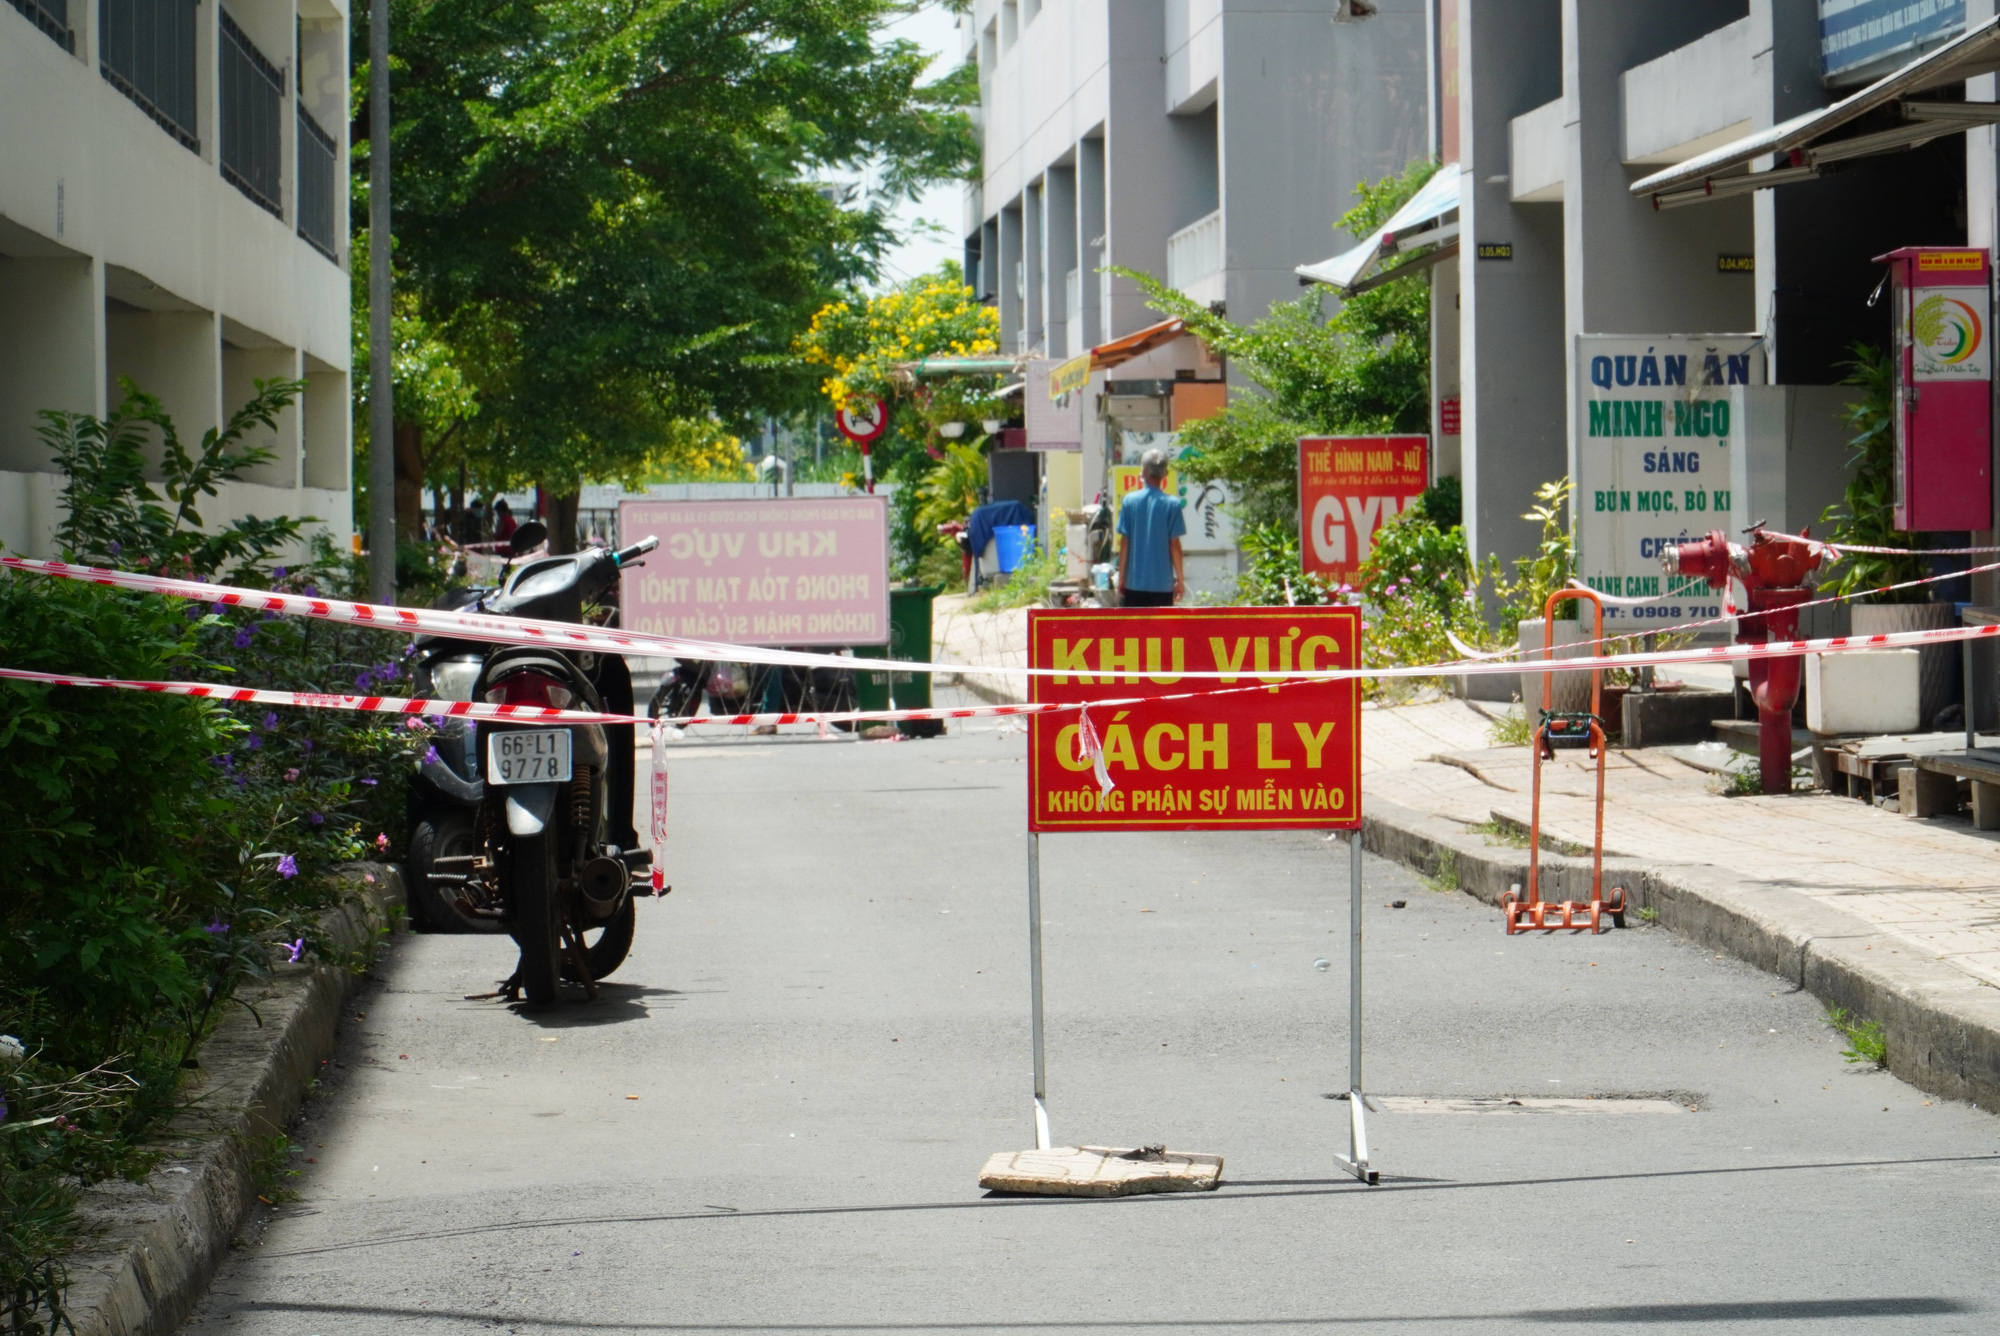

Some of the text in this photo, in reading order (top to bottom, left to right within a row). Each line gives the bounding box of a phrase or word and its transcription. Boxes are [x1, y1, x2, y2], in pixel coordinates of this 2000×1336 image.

[1590, 346, 1750, 391] QUÁN ĂN
[1588, 400, 1664, 437] MINH
[1307, 441, 1331, 472] THỂ
[1335, 446, 1364, 472] HÌNH
[1366, 450, 1393, 472] NAM
[1404, 445, 1421, 472] NỮ
[1643, 446, 1699, 473] SÁNG
[1594, 485, 1631, 512] BÚN
[1637, 490, 1678, 518] MỌC,
[1685, 485, 1707, 512] BÒ
[1633, 606, 1682, 618] 0908
[1688, 606, 1720, 618] 710
[1052, 626, 1341, 694] KHU VỰC
[1055, 710, 1229, 772] CÁCH
[1256, 721, 1336, 769] LY
[501, 757, 558, 779] 9778
[1048, 778, 1345, 815] KHÔNG PHẬN SỰ MIỄN VÀO
